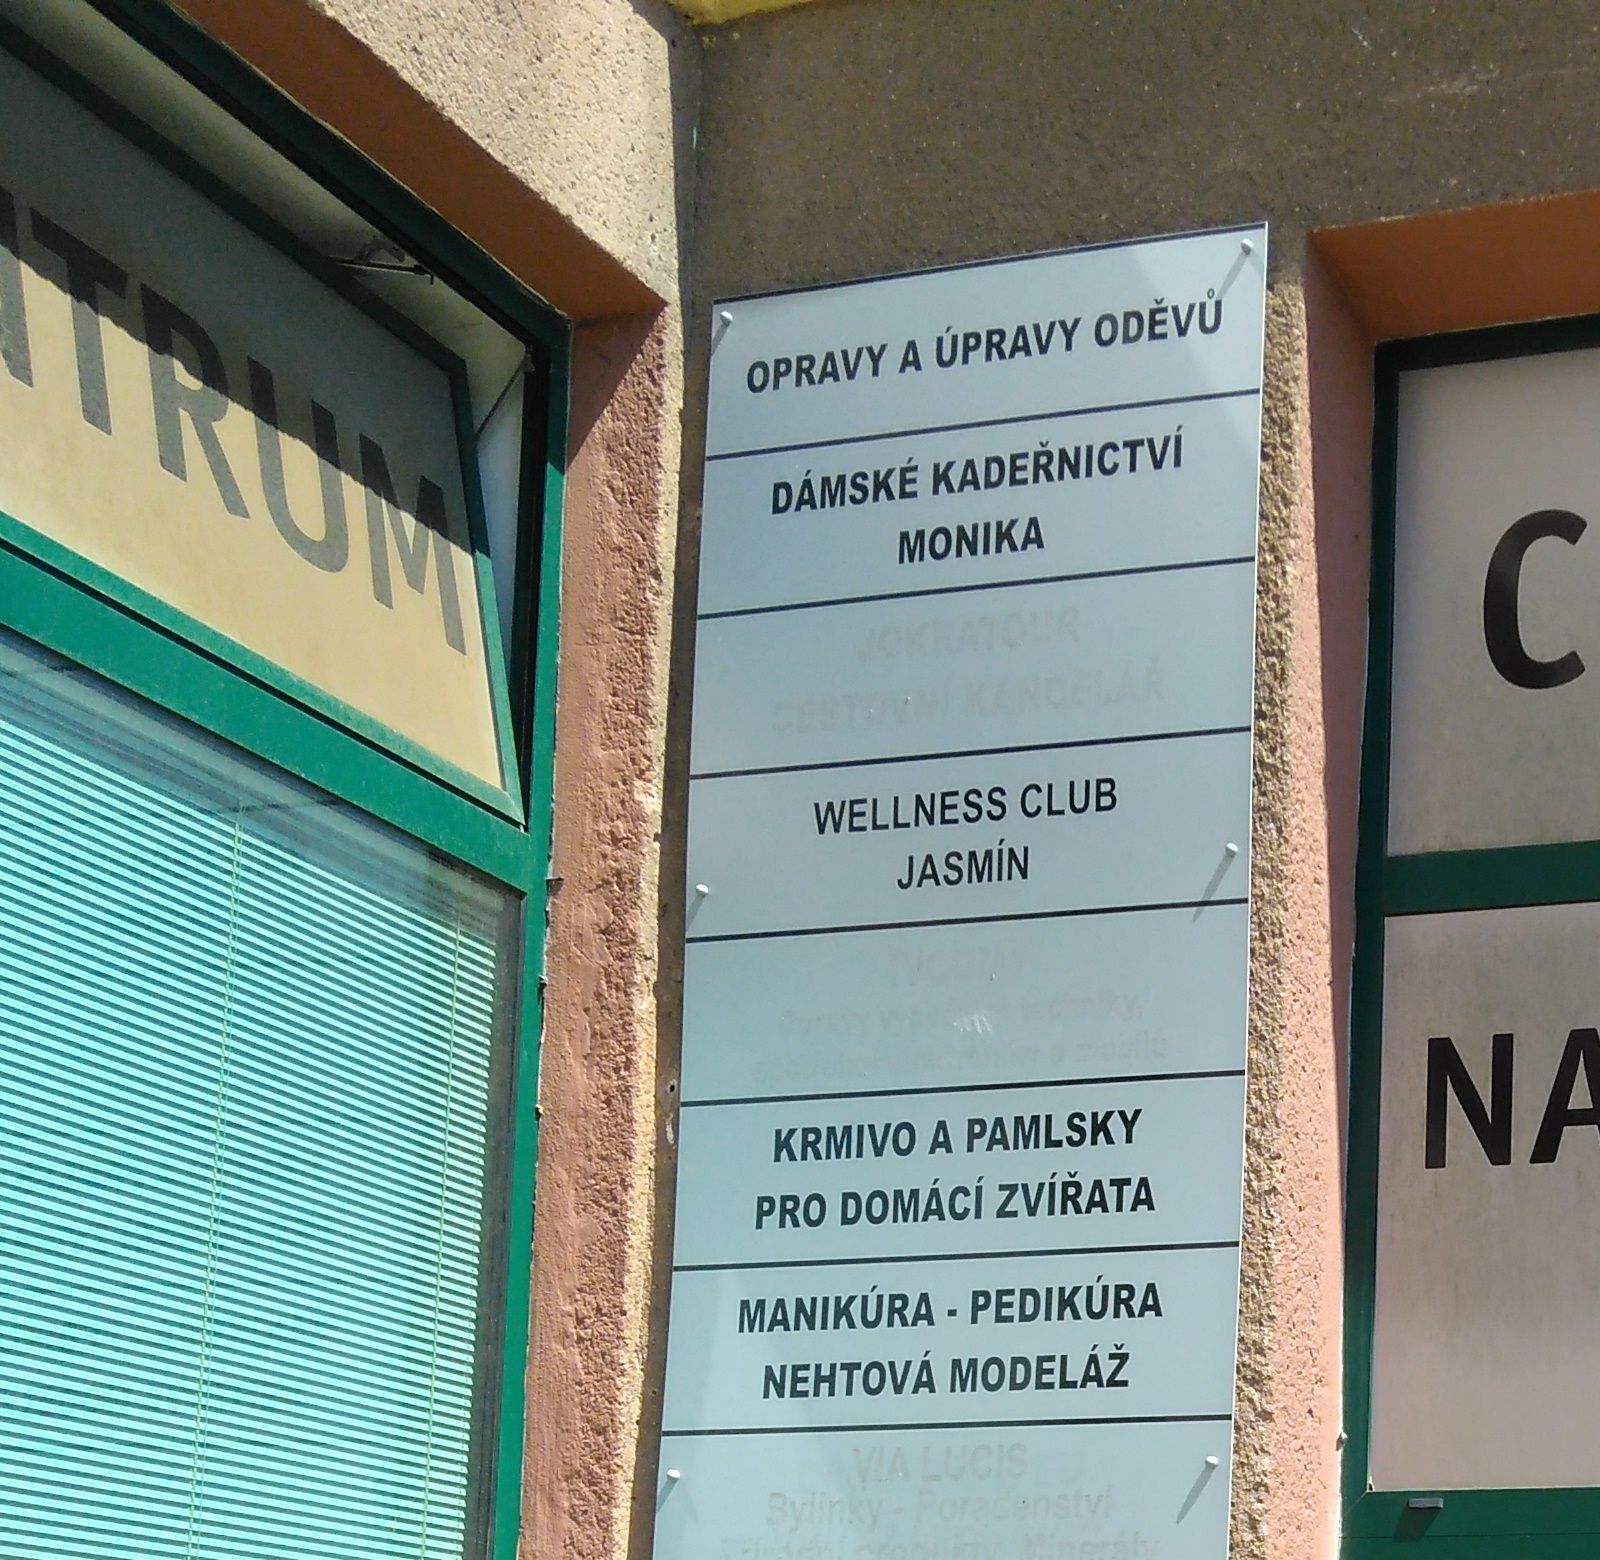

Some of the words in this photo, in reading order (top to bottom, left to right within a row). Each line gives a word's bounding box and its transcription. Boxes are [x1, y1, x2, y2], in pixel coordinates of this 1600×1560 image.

[747, 343, 888, 394] OPRAVY
[899, 339, 922, 374] A
[935, 317, 1081, 368] ÚPRAVY
[1093, 288, 1223, 347] ODĚVŮ
[771, 457, 918, 515] DÁMSKÉ
[932, 425, 1184, 494] KADEŘNICTVÍ
[898, 516, 1045, 565] MONIKA
[814, 786, 1007, 835] WELLNESS
[1020, 777, 1118, 818] CLUB
[897, 838, 1030, 890] JASMÍN
[773, 1120, 916, 1163] KRMIVO
[928, 1120, 953, 1155] A
[966, 1108, 1142, 1153] PAMLSKY
[755, 1191, 827, 1230] PRO
[841, 1176, 984, 1226] DOMÁCÍ
[995, 1171, 1155, 1219] ZVÍŘATA
[737, 1284, 935, 1334] MANIKÚRA
[970, 1275, 1163, 1324] PEDIKÚRA
[762, 1350, 936, 1400] NEHTOVÁ
[949, 1343, 1130, 1394] MODELÁŽ
